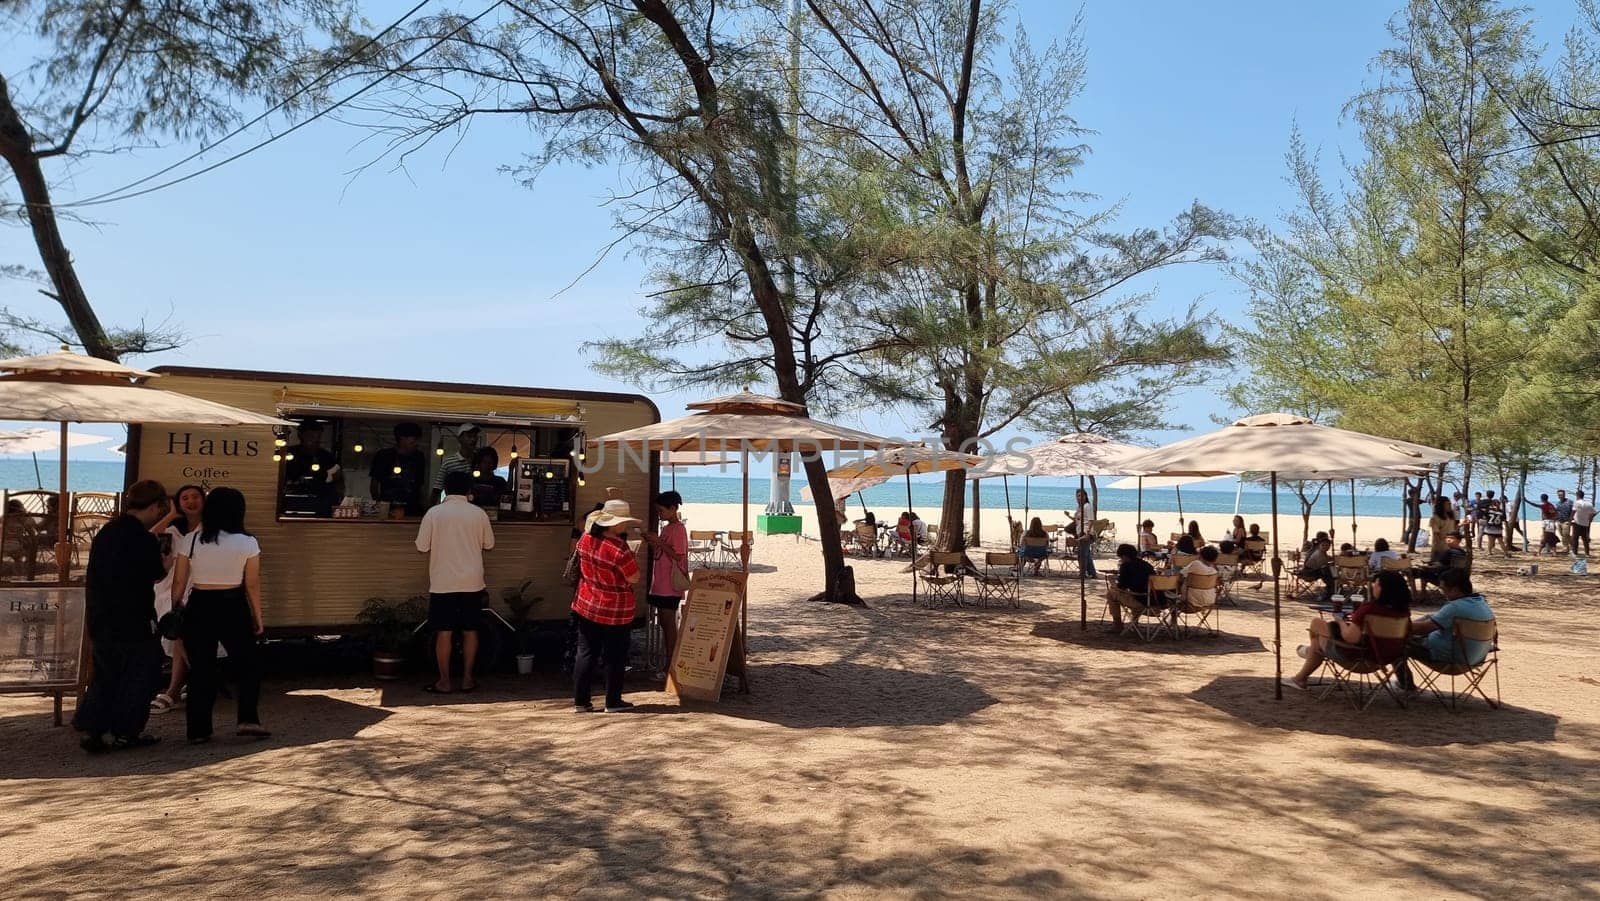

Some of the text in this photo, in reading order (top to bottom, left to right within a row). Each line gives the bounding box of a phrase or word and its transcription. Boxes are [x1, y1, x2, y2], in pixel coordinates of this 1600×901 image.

[167, 431, 259, 457] Haus
[183, 466, 230, 478] Coffee
[10, 601, 60, 612] Haus
